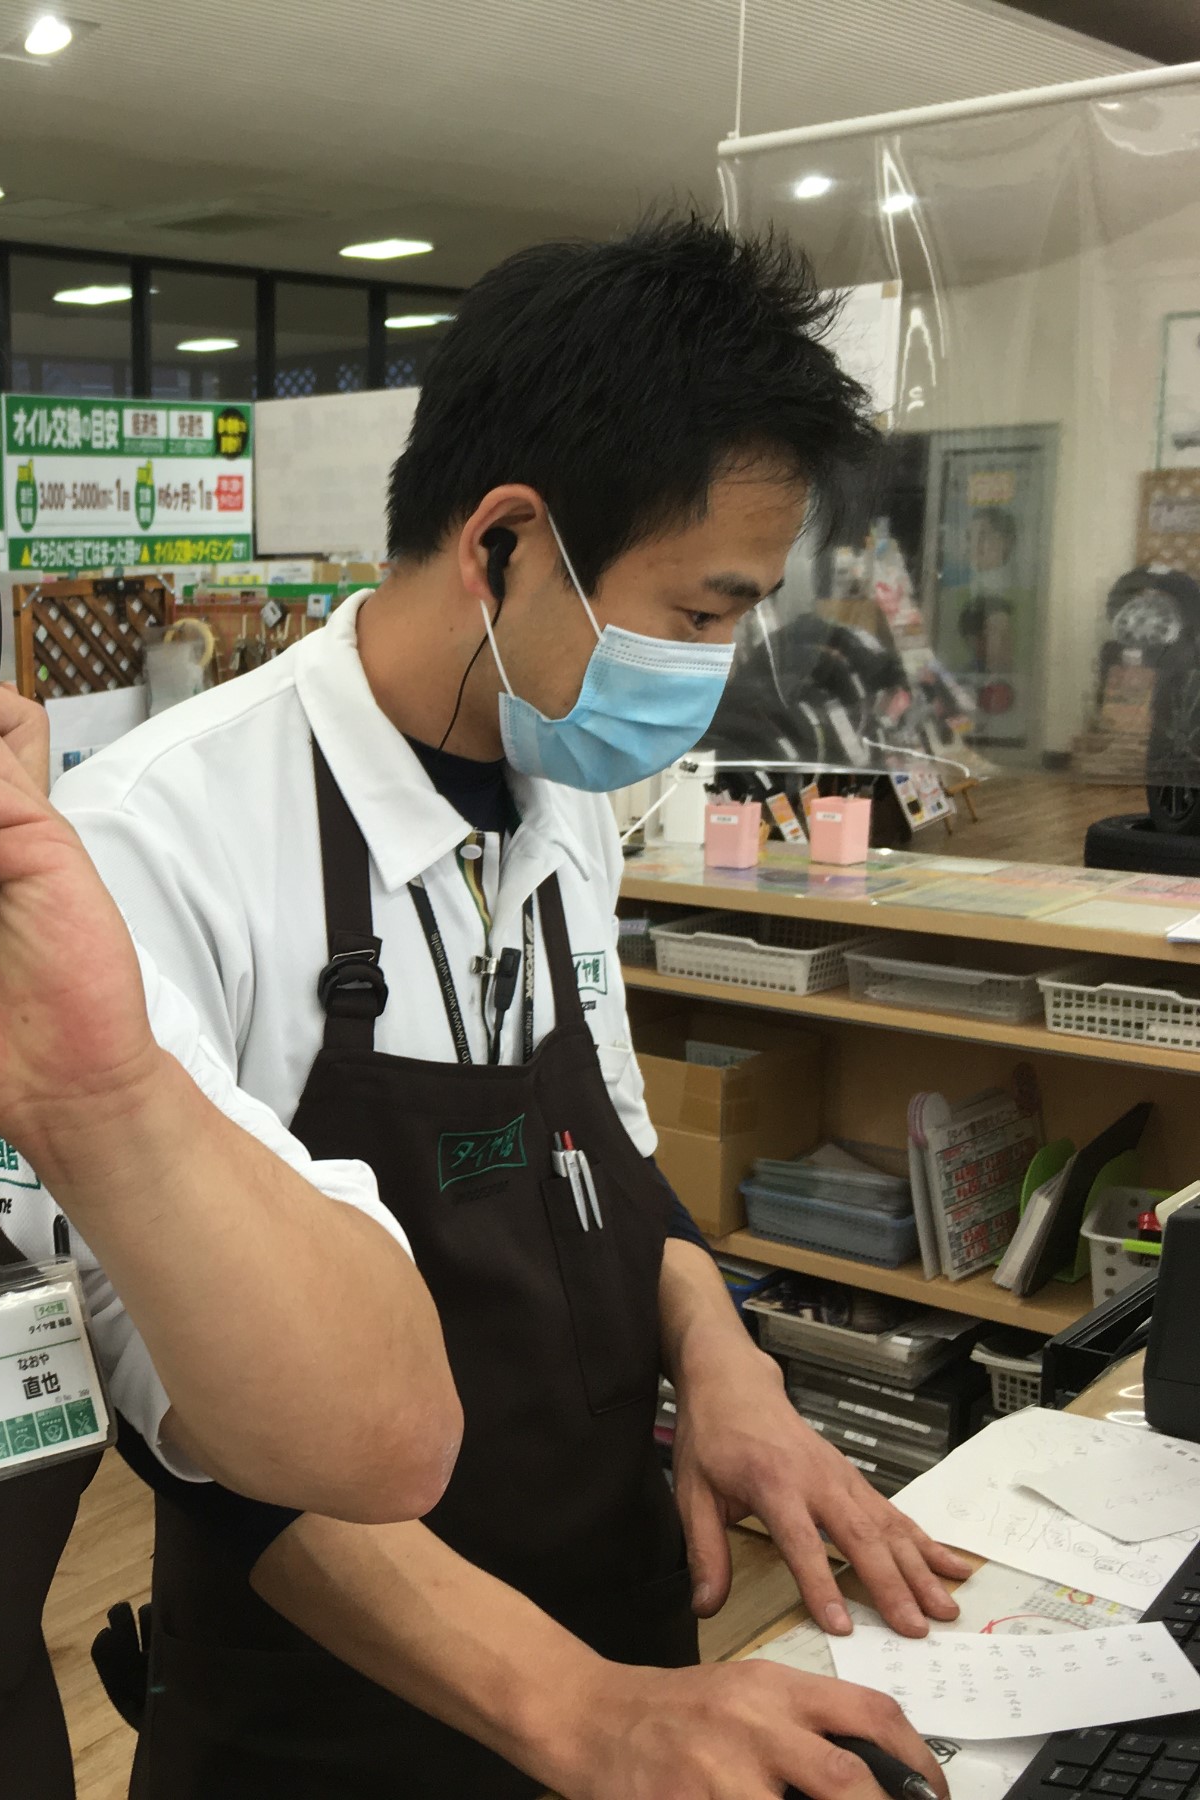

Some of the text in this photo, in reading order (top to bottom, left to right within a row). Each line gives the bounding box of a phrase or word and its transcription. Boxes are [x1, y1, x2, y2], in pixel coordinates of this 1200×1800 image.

[17, 1352, 50, 1371] なおや
[22, 1371, 62, 1400] 直也
